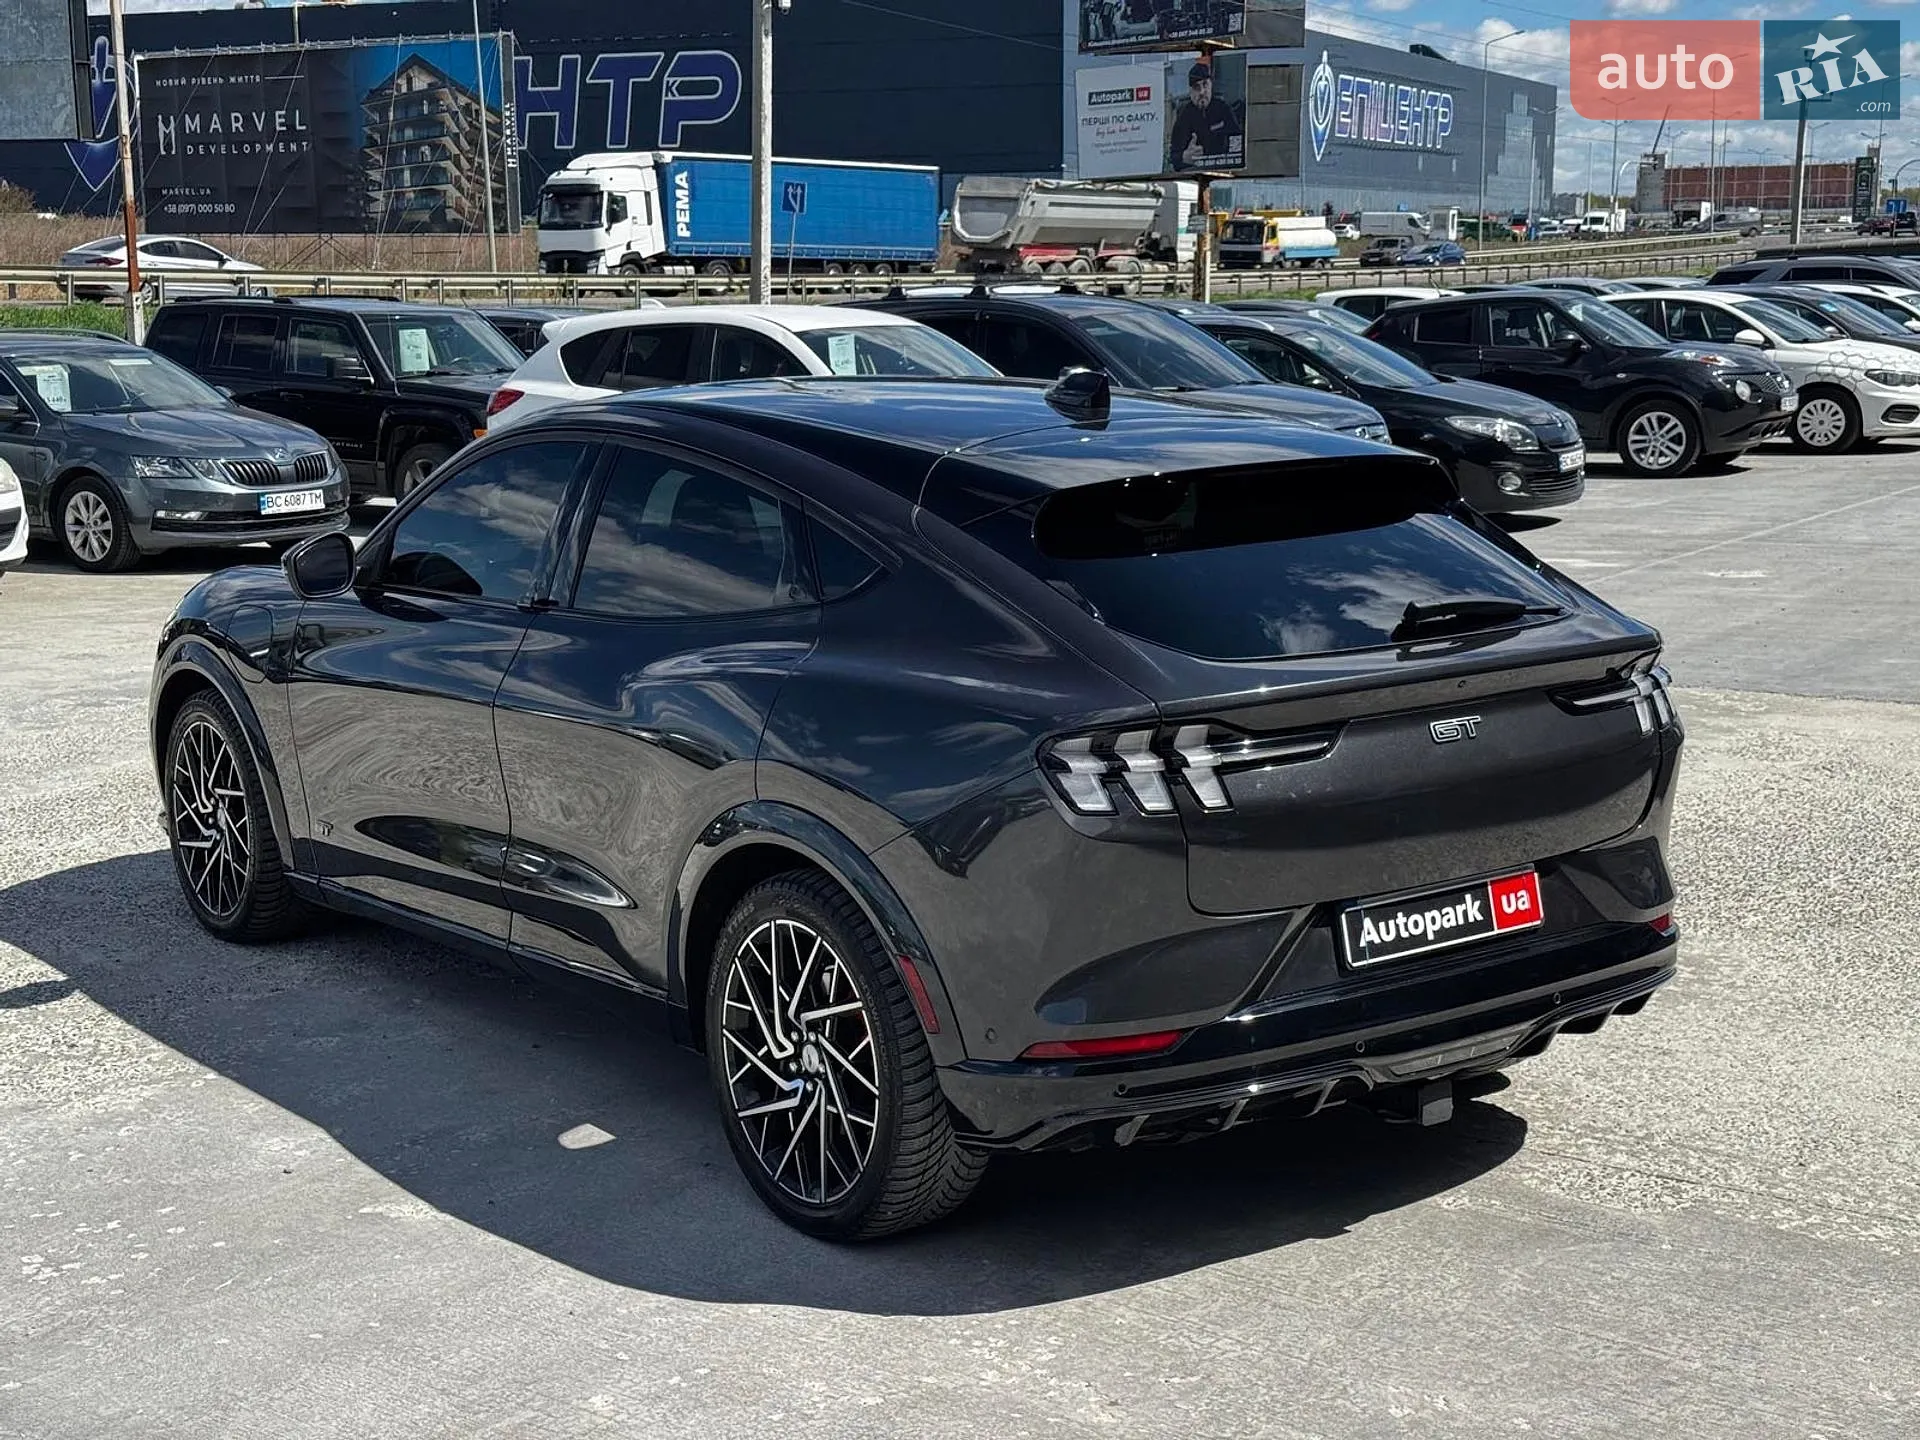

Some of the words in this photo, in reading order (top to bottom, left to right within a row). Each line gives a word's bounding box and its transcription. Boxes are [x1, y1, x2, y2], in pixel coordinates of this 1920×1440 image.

[155, 77, 187, 87] НОВИЙ
[191, 76, 225, 86] РІВЕНЬ
[229, 75, 261, 84] ЖИТТЯ
[1090, 89, 1132, 103] Autopark
[1335, 74, 1454, 149] ЕПІЦЕНТР
[184, 109, 307, 134] MARVEL
[1081, 115, 1110, 127] ПЕРШІ
[1112, 114, 1124, 124] ПО
[187, 142, 308, 155] DEVELOPMENT
[162, 187, 211, 196] MARVEL.UA
[164, 204, 177, 213] +38
[197, 204, 214, 213] 000
[675, 170, 691, 238] PEMA
[266, 496, 282, 509] BC
[284, 493, 306, 507] 6087
[308, 491, 322, 505] TM
[1429, 715, 1481, 742] GT
[1359, 894, 1484, 948] Autopark
[1500, 889, 1532, 915] ua
